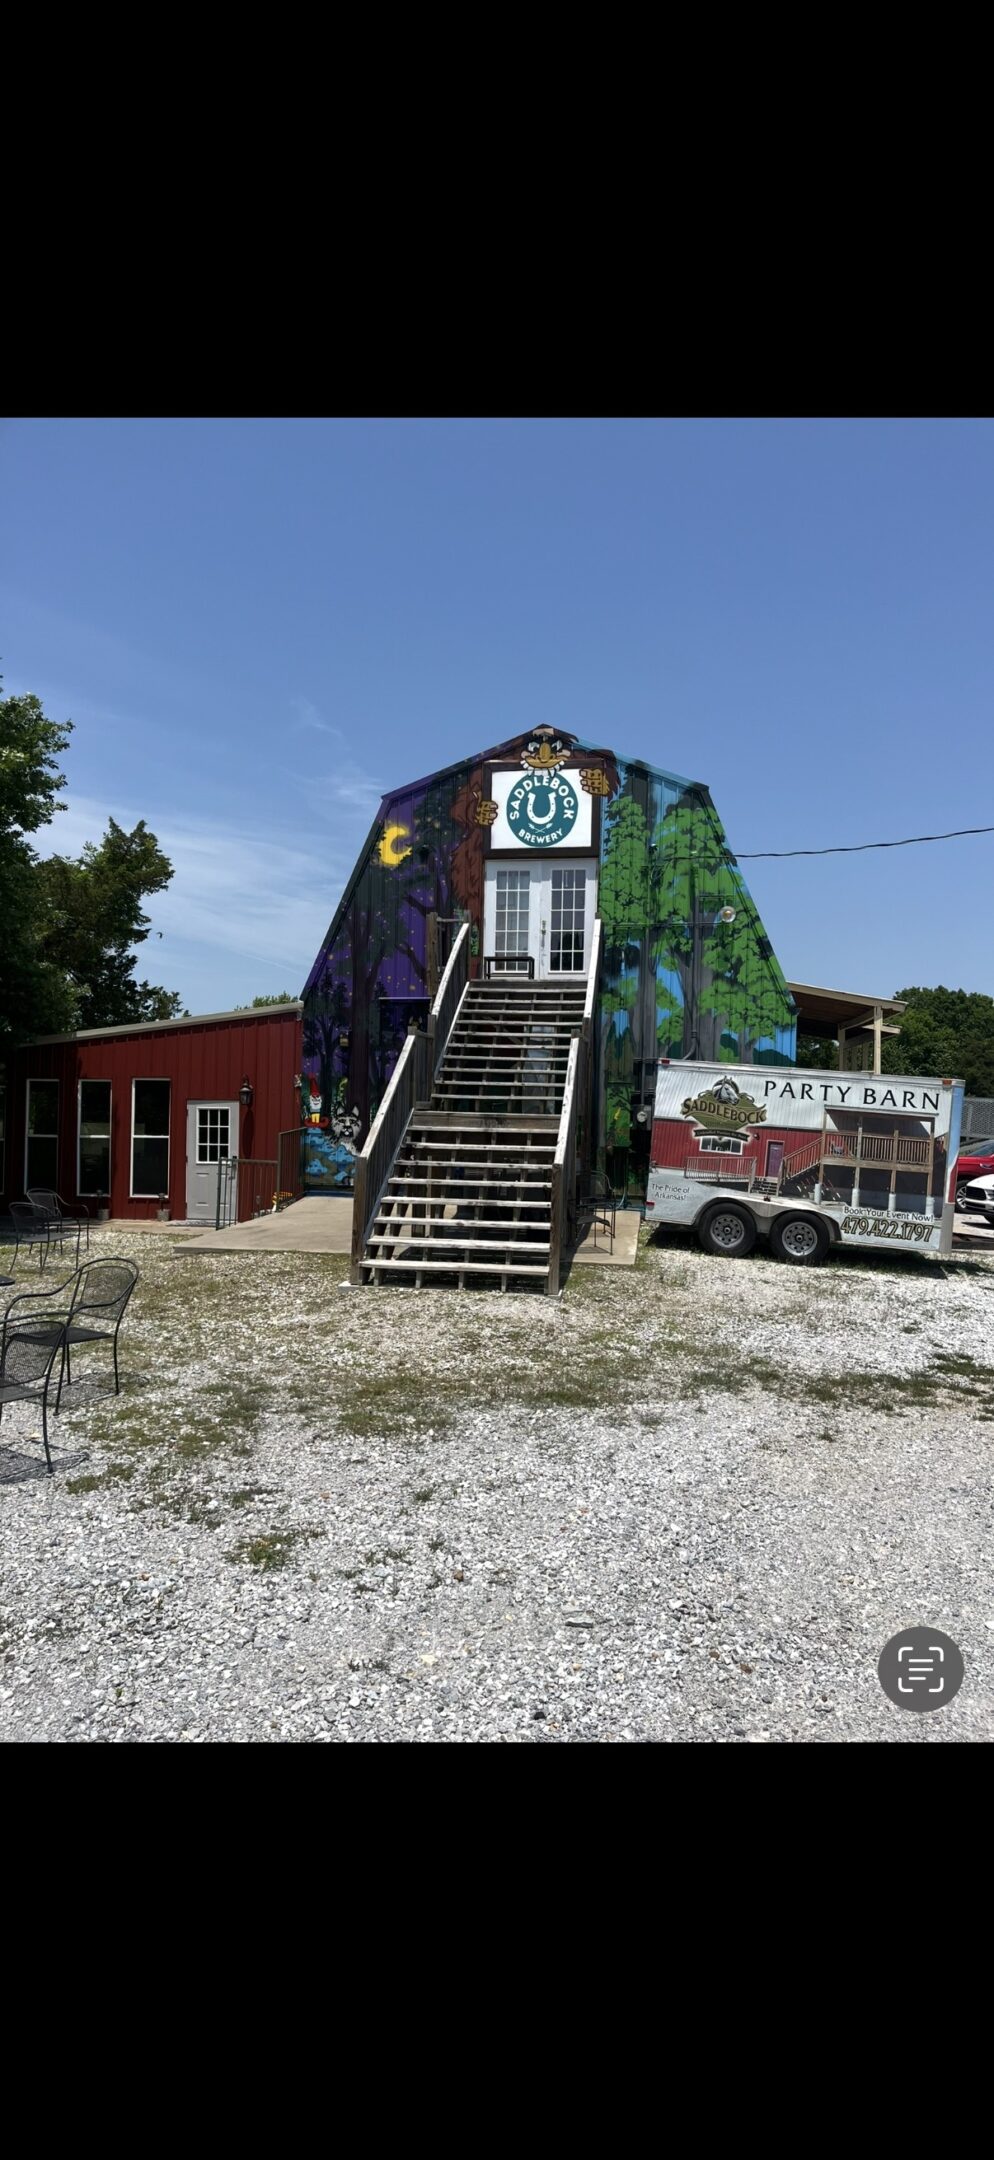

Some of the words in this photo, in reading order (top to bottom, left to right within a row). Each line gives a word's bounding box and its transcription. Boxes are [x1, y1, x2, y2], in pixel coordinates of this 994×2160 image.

[510, 775, 575, 820] SADDLEBOCK
[518, 828, 563, 844] BREWERY
[764, 1080, 852, 1103] PARTY
[863, 1088, 940, 1111] BARN
[682, 1097, 768, 1124] SADDLEBOCK
[664, 1185, 682, 1193] Pride
[844, 1206, 864, 1215] Book
[866, 1208, 884, 1217] Your
[886, 1211, 909, 1219] Event
[911, 1213, 934, 1222] Now!
[840, 1216, 935, 1242] 479.422.1797
